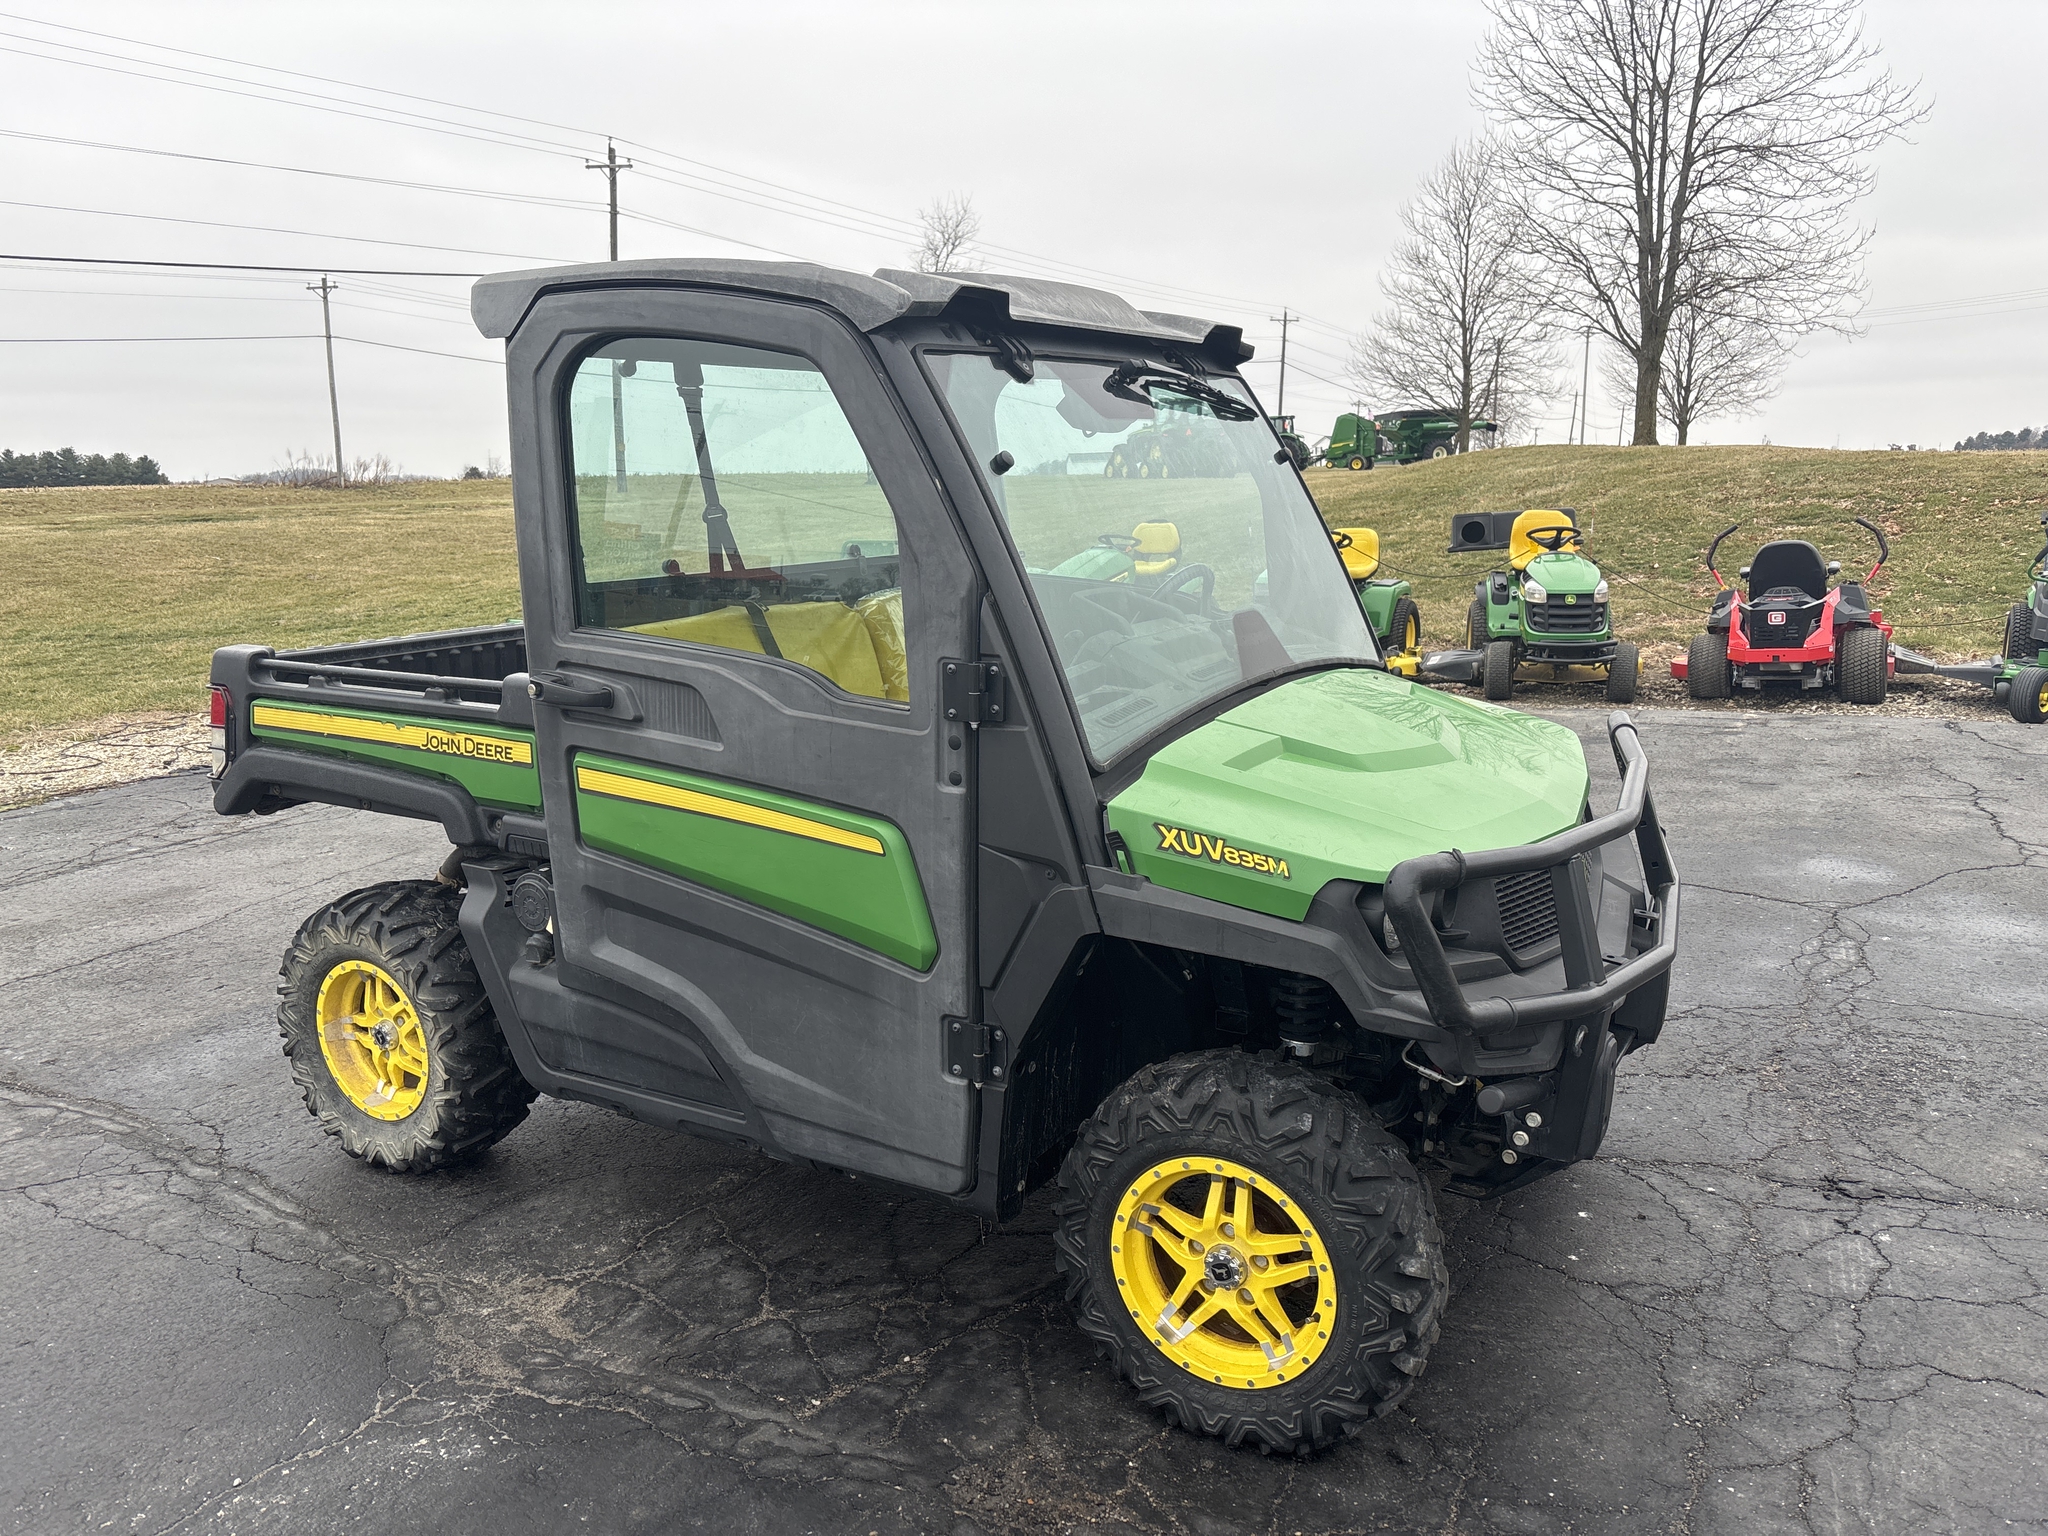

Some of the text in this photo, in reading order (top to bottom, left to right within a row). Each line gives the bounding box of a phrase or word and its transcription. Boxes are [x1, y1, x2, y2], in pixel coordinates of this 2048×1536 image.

[421, 731, 513, 761] JOHN DEERE
[1153, 822, 1291, 879] XUV835M
[1127, 1334, 1299, 1409] BIGHORN 2.0
[1337, 1336, 1355, 1366] RADIAL
